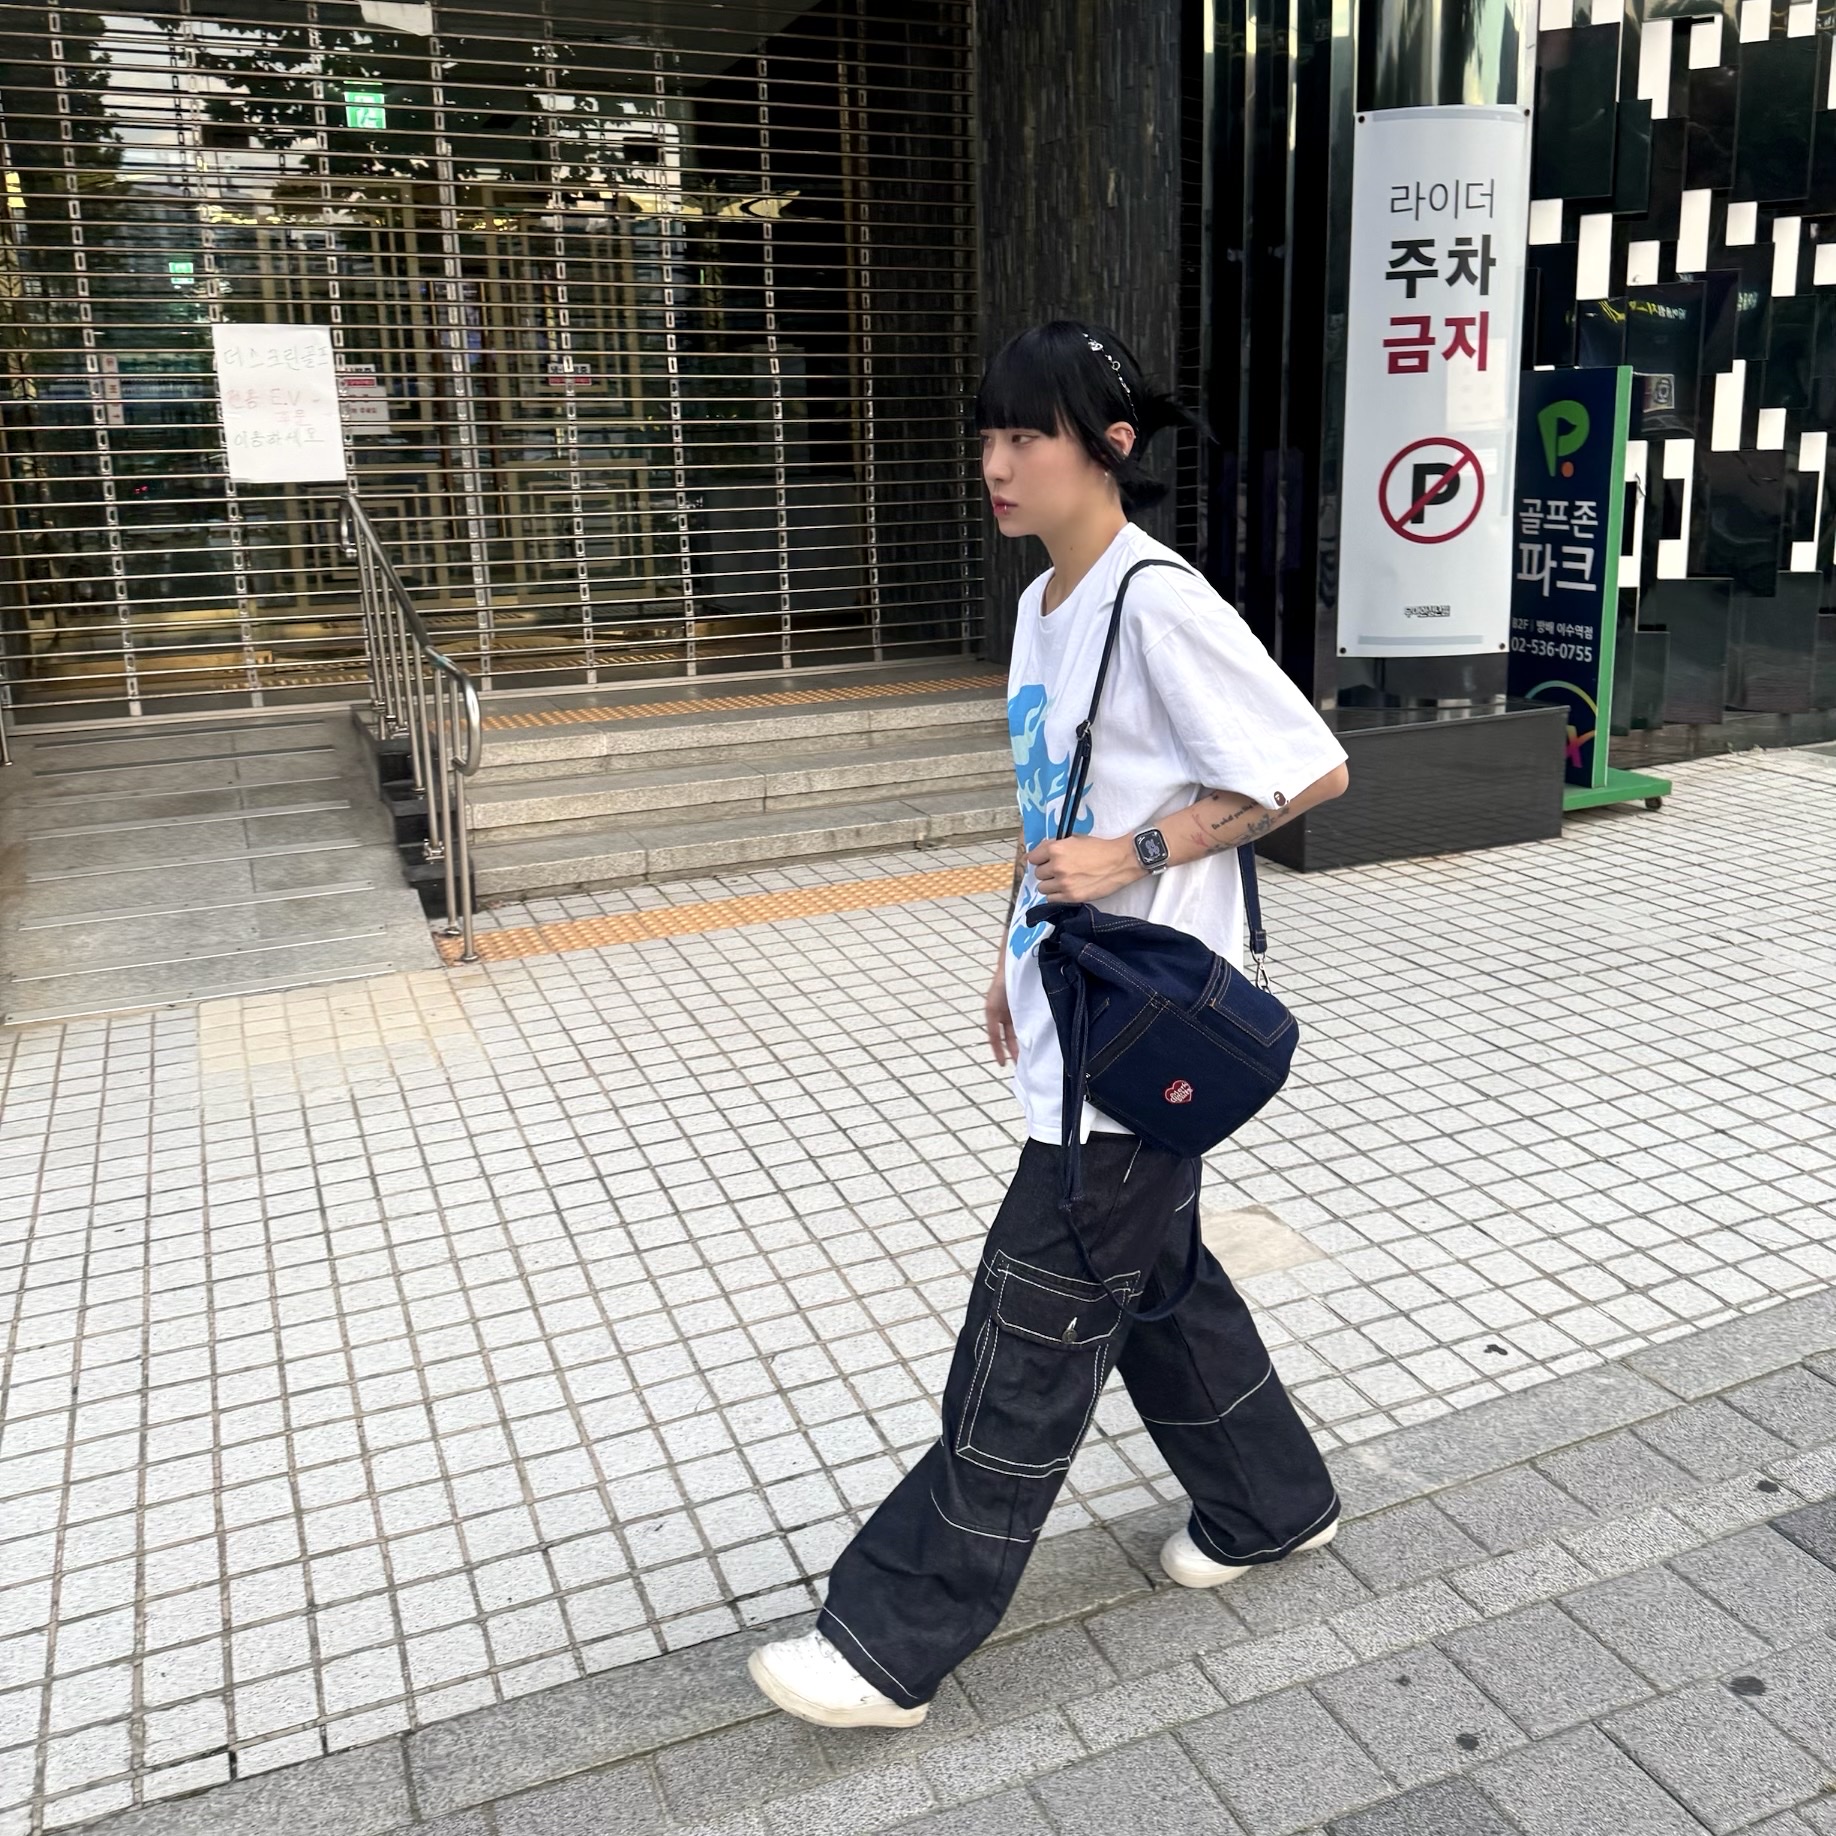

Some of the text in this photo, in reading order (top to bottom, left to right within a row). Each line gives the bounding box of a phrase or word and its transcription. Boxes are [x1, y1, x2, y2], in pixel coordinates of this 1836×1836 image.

[1390, 179, 1495, 222] 라이더
[1385, 234, 1497, 299] 주차
[1382, 311, 1490, 375] 금지
[1519, 498, 1599, 539] 골프존
[1516, 542, 1597, 597] 파크
[1511, 636, 1593, 662] 02-536-0755
[1536, 620, 1555, 635] 방배
[1556, 622, 1594, 640] 이수역점
